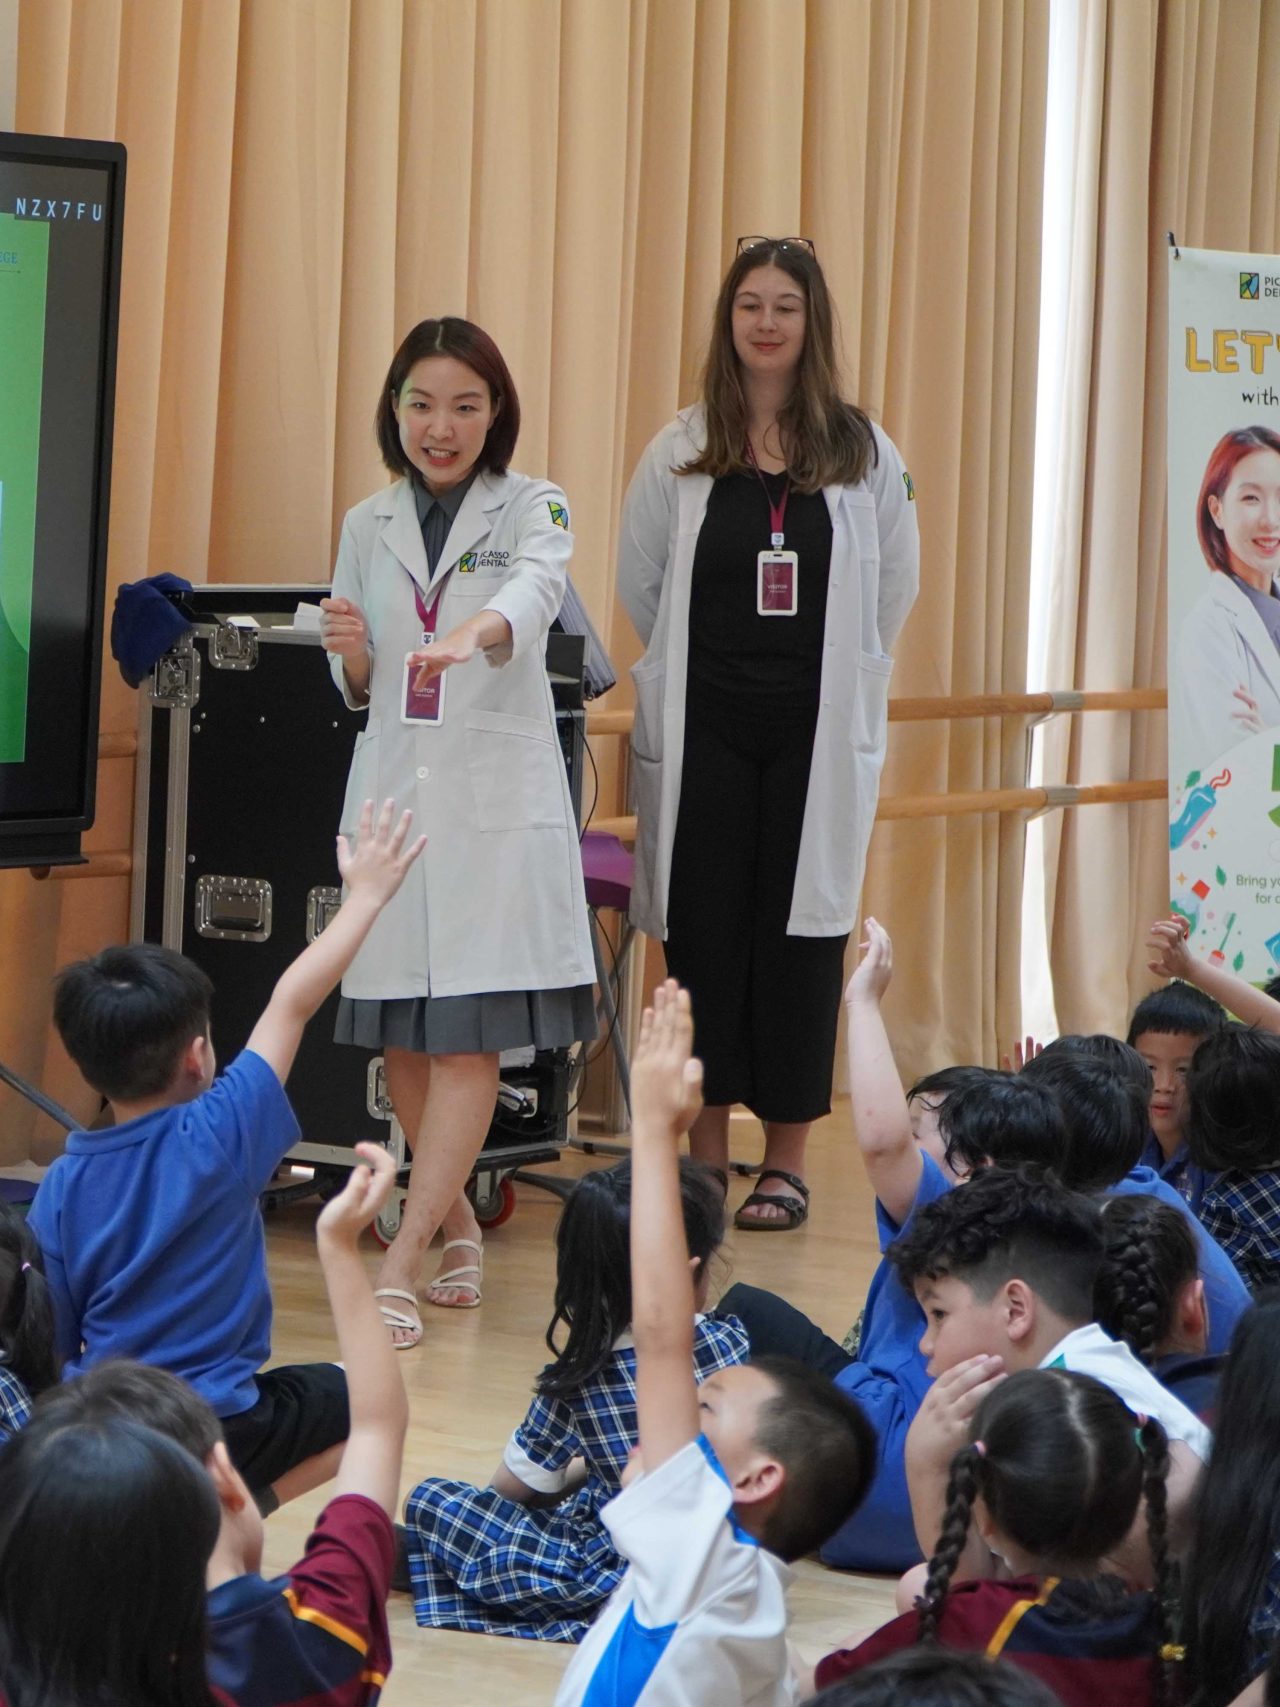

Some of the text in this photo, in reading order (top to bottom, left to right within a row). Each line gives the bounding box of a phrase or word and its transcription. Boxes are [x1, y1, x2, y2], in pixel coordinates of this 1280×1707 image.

[1264, 287, 1280, 298] DE
[1241, 386, 1279, 406] with
[477, 558, 509, 568] ENTAL
[1235, 874, 1268, 889] Bring
[1255, 891, 1272, 904] for
